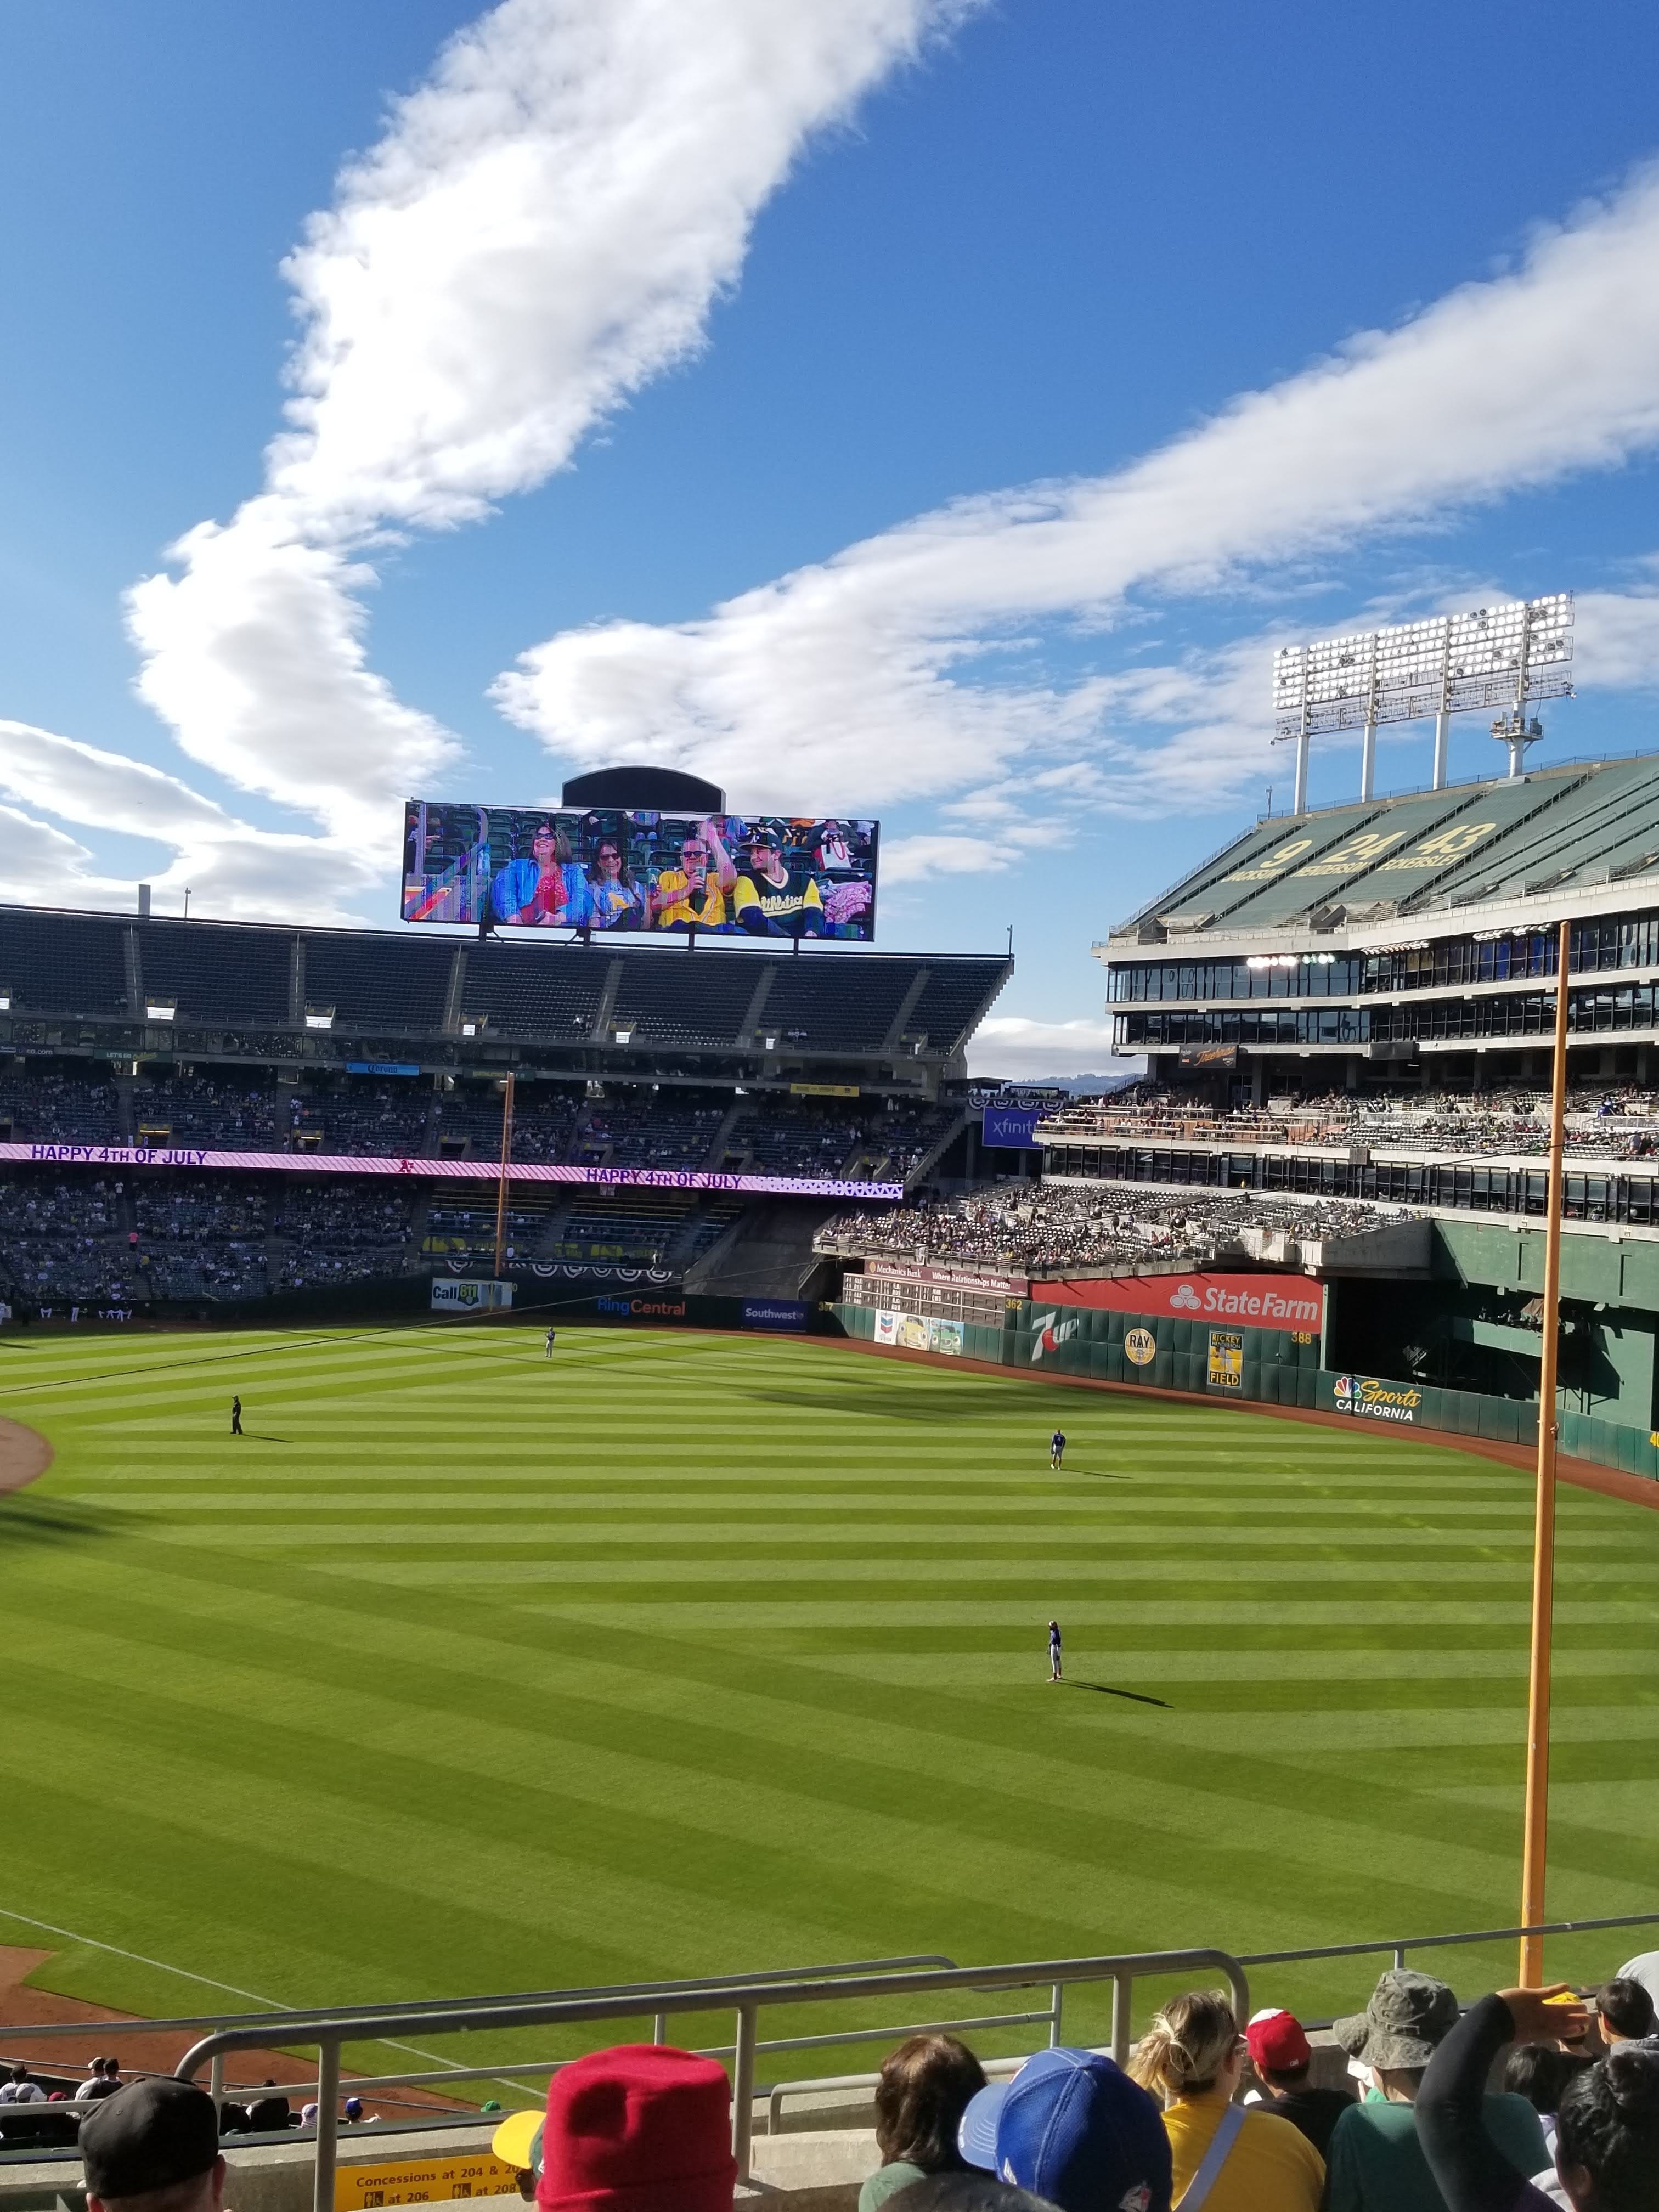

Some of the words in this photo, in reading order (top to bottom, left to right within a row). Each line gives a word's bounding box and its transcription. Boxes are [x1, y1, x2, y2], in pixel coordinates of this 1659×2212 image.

[1321, 831, 1408, 864] 24
[1415, 823, 1497, 855] 43
[1260, 839, 1312, 868] 9
[1375, 853, 1467, 871] ECKERSLEY
[1221, 868, 1286, 883] JACKSON
[1290, 861, 1375, 878] HENDERSON
[32, 1145, 94, 1160] HAPPY
[99, 1148, 129, 1162] 4TH
[135, 1149, 158, 1163] OF
[162, 1150, 208, 1165] JULY
[586, 1169, 642, 1183] HAPPY
[645, 1172, 673, 1186] 4TH
[677, 1173, 698, 1186] OF
[702, 1175, 742, 1189] JULY
[877, 1263, 906, 1276] Mechanics
[907, 1268, 922, 1278] Bank
[932, 1271, 950, 1282] Where
[951, 1273, 990, 1288] Relationships
[991, 1279, 1011, 1290] Matter
[433, 1286, 457, 1300] Call
[460, 1284, 478, 1298] 811
[597, 1297, 685, 1316] RingCentral
[1006, 1299, 1022, 1310] 362
[746, 1308, 797, 1320] Southwest
[1130, 1334, 1150, 1348] RAY
[1212, 1333, 1240, 1344] RICKEY
[1210, 1372, 1239, 1385] FIELD
[1361, 1380, 1422, 1407] Sports
[1336, 1399, 1413, 1421] CALIFORNIA
[357, 2172, 437, 2187] Concessions
[442, 2169, 455, 2179] at
[461, 2167, 483, 2178] 204
[489, 2165, 498, 2175] &
[505, 2164, 522, 2174] 20
[388, 2194, 401, 2204] at
[407, 2191, 429, 2202] 206
[475, 2187, 488, 2196] at
[494, 2183, 516, 2194] 208
